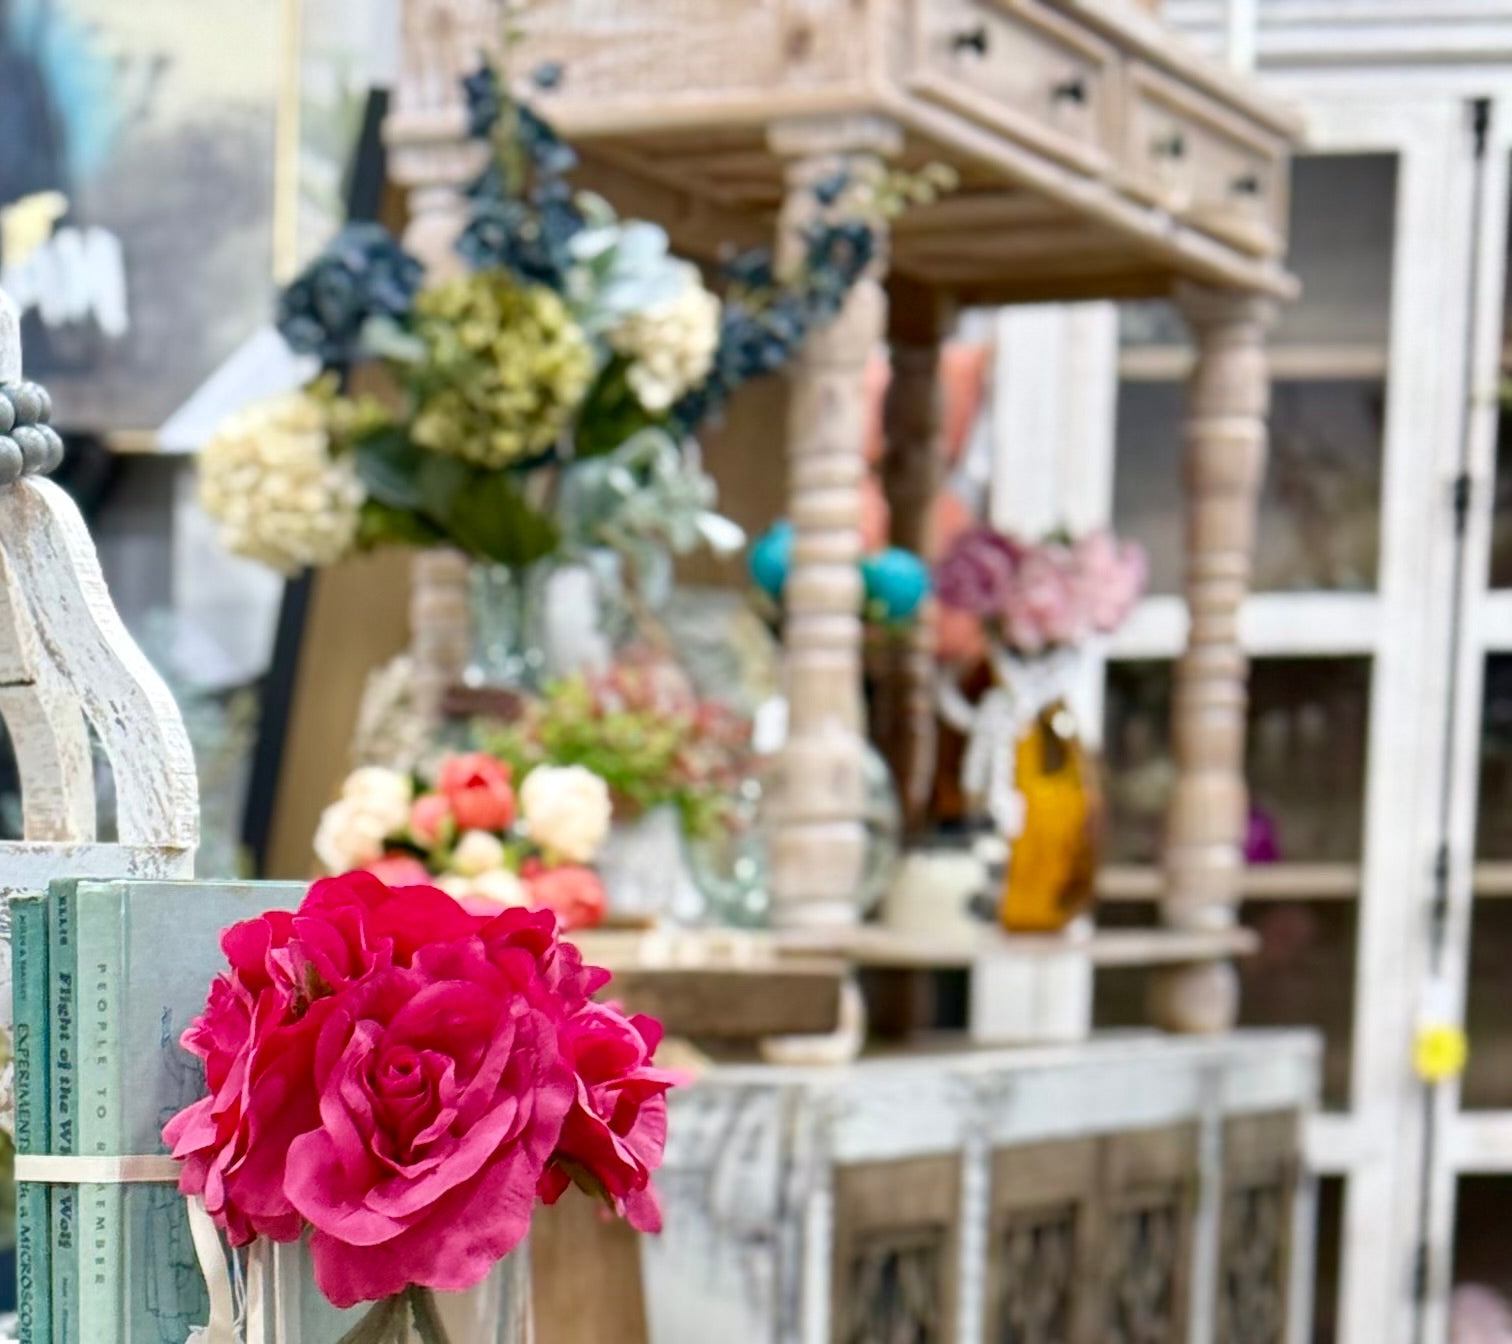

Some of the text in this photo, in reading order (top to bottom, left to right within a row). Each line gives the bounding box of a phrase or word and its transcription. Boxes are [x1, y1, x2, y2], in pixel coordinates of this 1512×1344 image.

[58, 972, 72, 1040] Flight
[58, 1049, 72, 1070] of
[59, 1075, 72, 1114] the
[94, 963, 108, 1284] PEOPLE TO REMBER
[58, 1196, 73, 1249] Wolf
